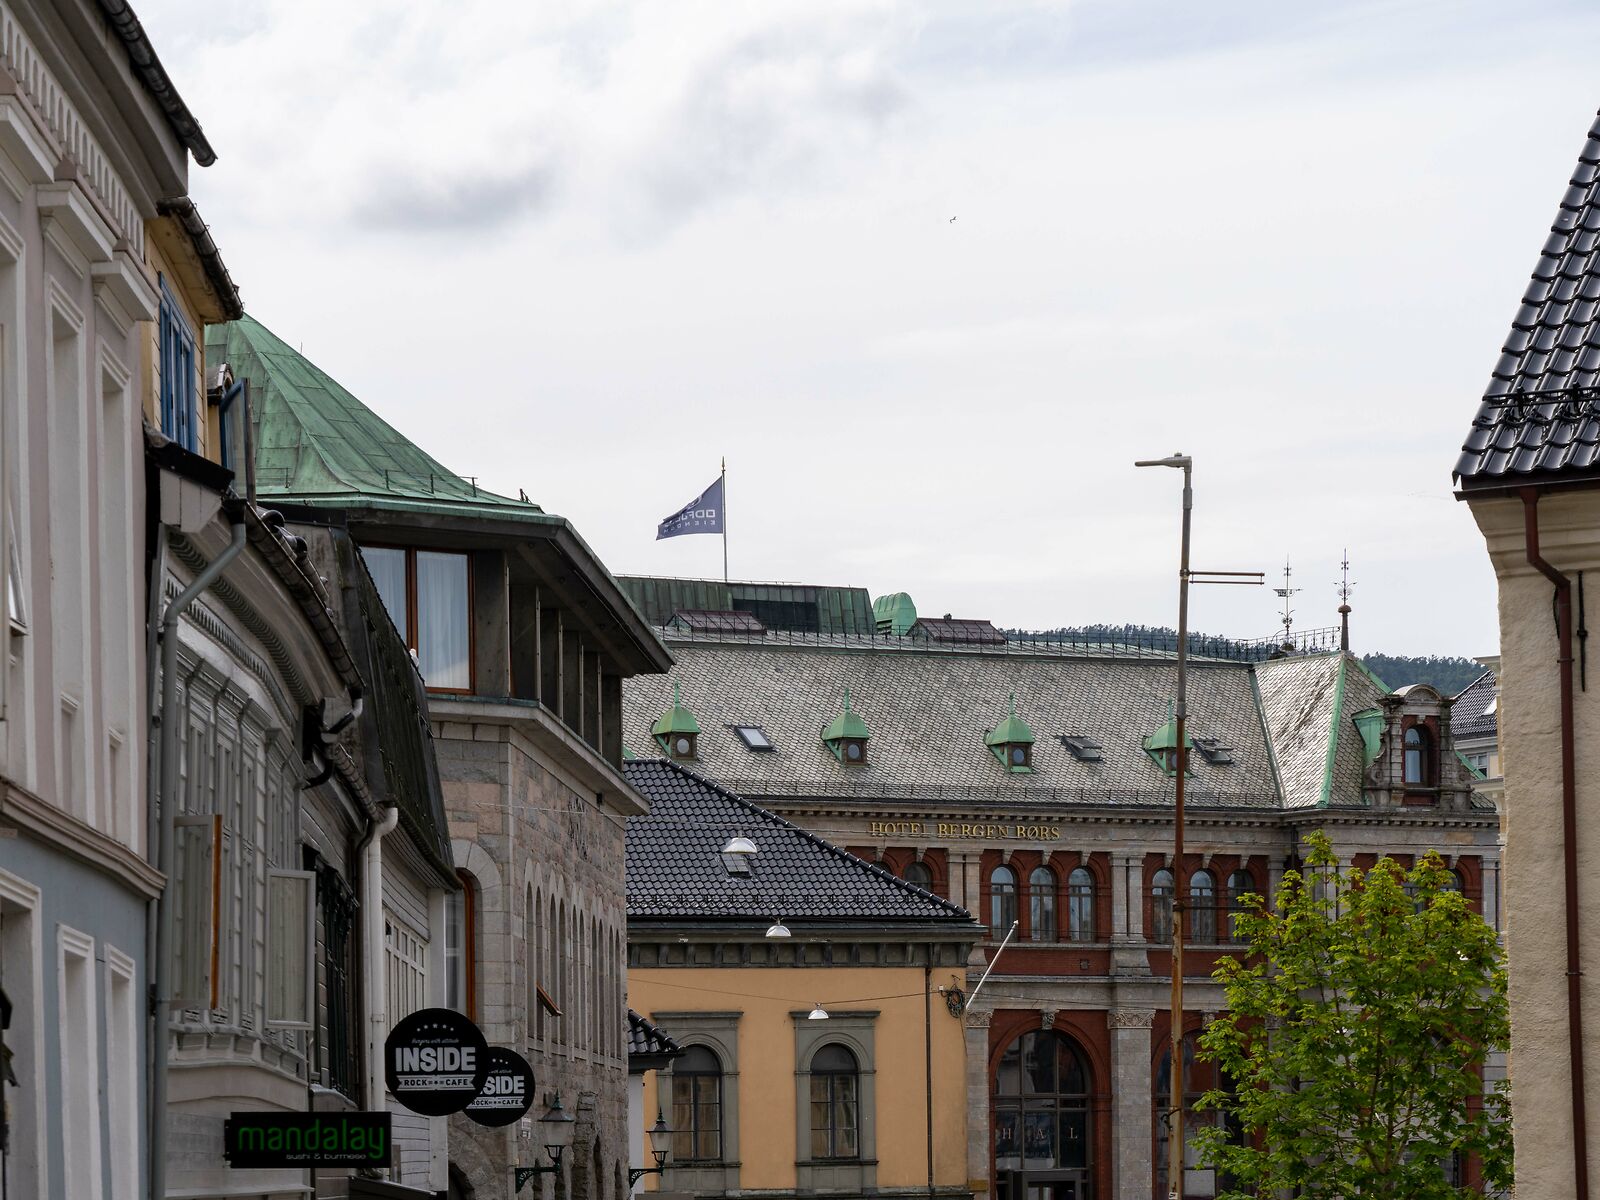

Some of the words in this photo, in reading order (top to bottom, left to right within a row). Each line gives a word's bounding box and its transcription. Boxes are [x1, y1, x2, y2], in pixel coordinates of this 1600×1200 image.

[871, 822, 928, 837] HOTEL
[937, 823, 1009, 838] BERGEN
[1016, 825, 1060, 839] BØRS
[395, 1046, 476, 1072] INSIDE
[480, 1075, 525, 1095] SIDE
[238, 1118, 384, 1159] mandalay
[313, 1152, 321, 1160] &
